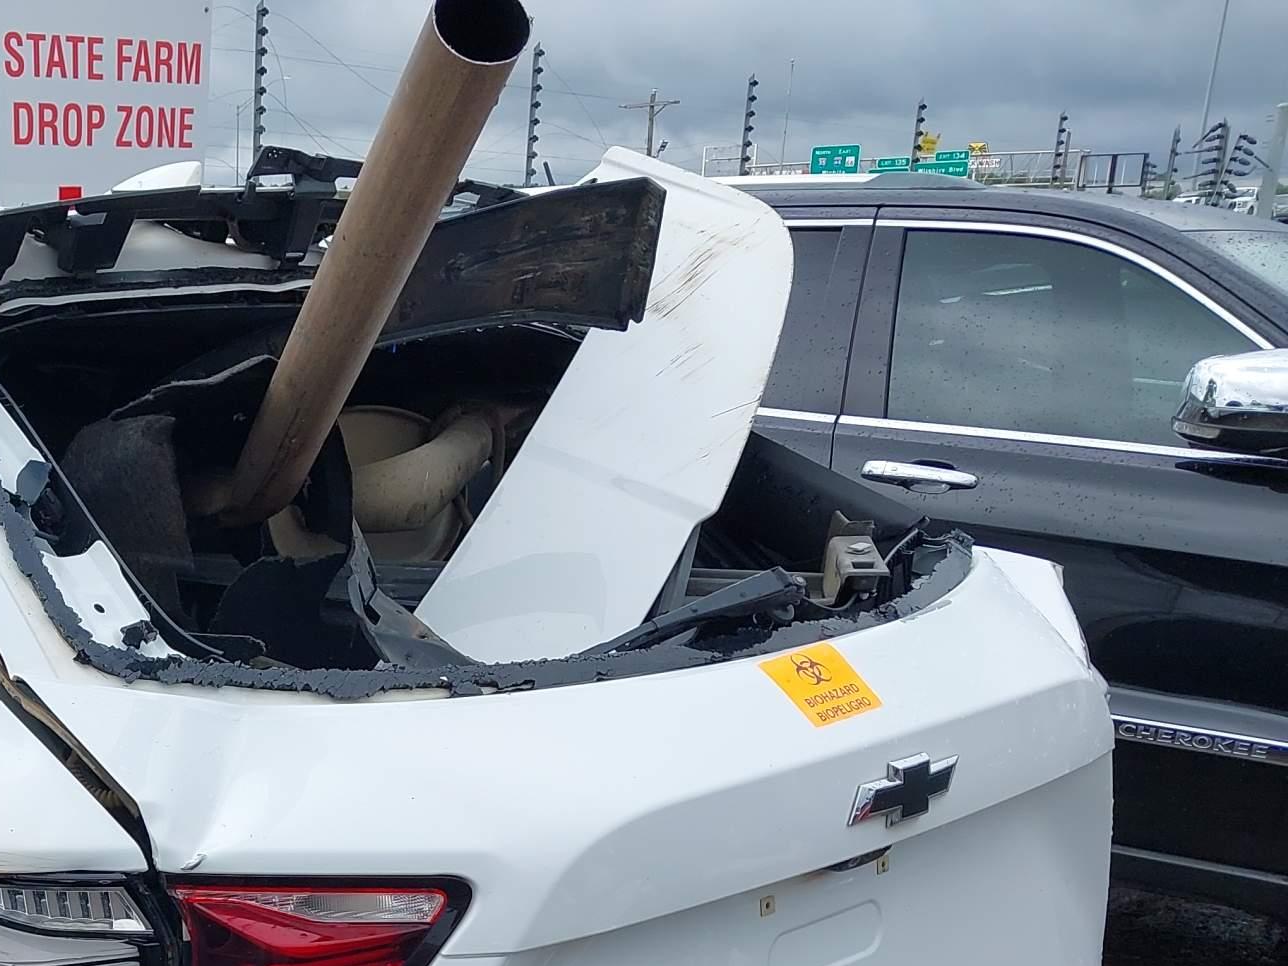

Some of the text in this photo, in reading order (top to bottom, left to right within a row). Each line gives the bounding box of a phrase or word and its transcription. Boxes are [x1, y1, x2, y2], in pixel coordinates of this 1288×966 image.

[3, 31, 202, 85] STATE FARM
[13, 102, 195, 149] DROP ZONE
[948, 165, 964, 173] Blvd
[804, 683, 860, 708] BIOHAZARD
[816, 696, 872, 722] BIOPELIGRO
[1118, 723, 1272, 759] CHEROKEE
